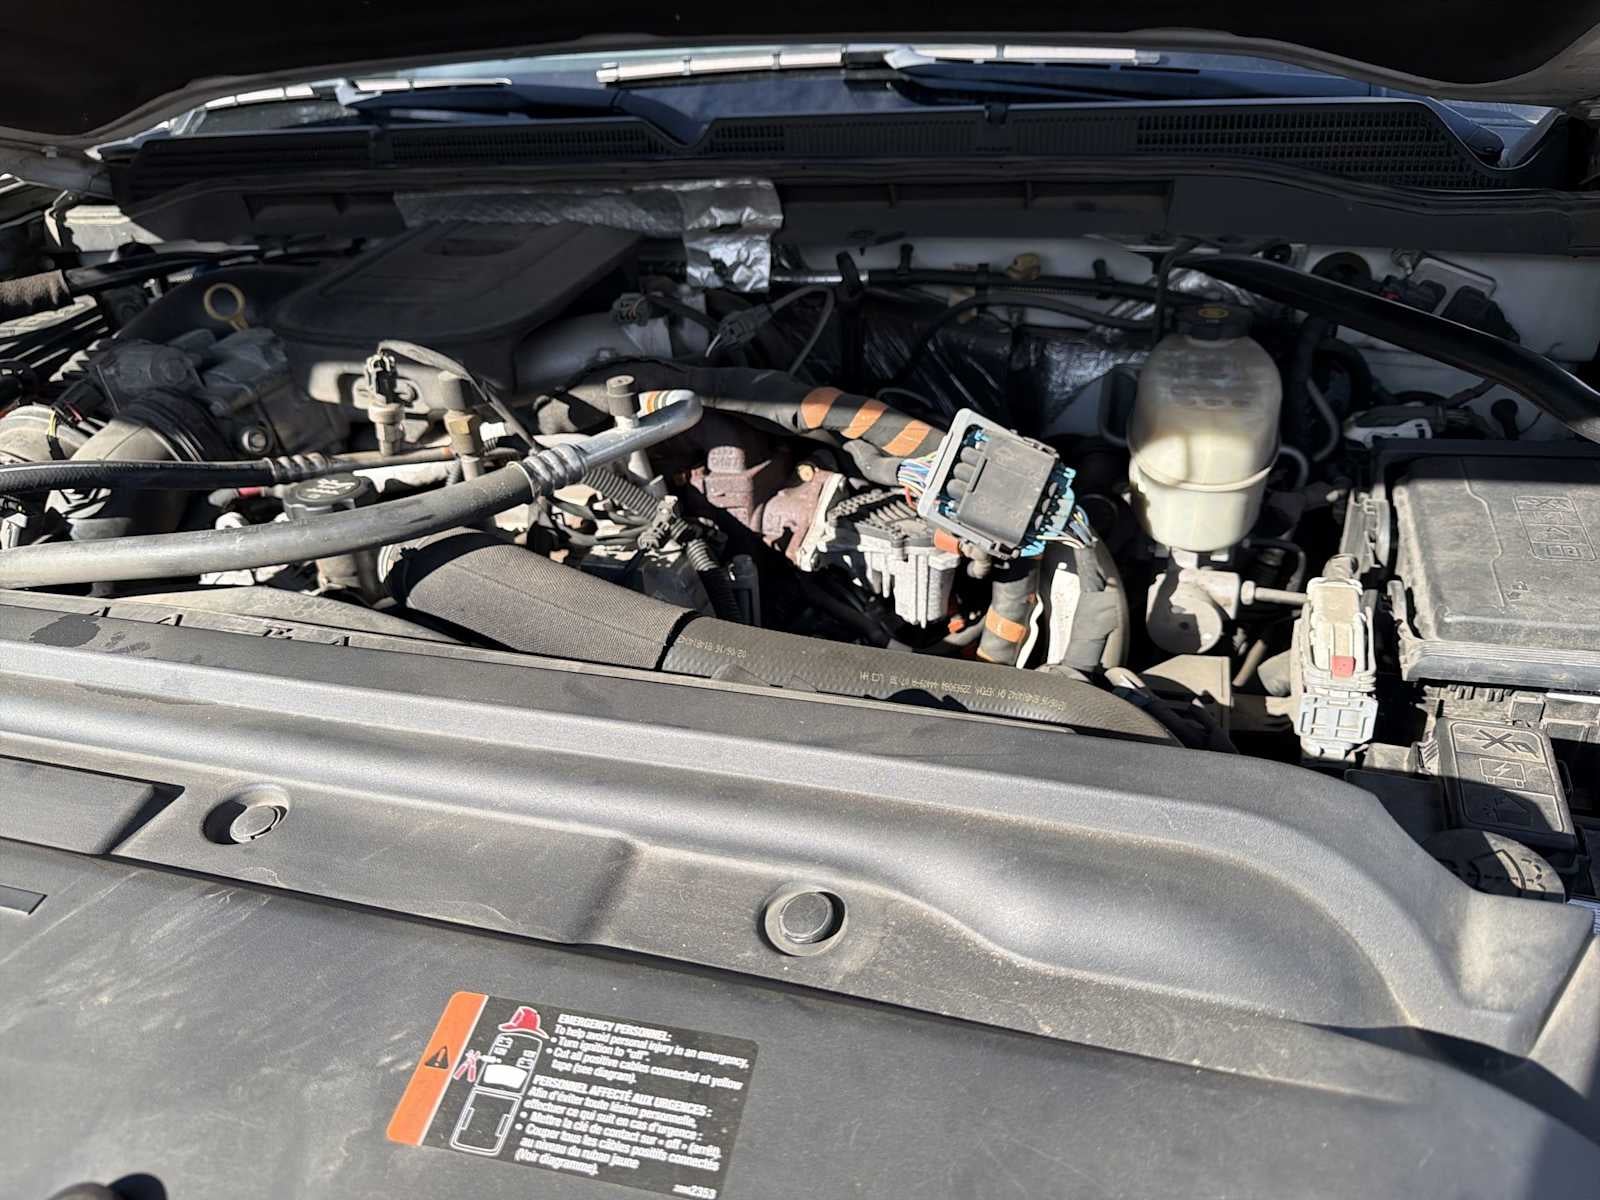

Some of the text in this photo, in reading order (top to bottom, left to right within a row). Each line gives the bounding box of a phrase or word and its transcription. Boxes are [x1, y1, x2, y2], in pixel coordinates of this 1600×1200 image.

[555, 1024, 566, 1034] To
[566, 1027, 585, 1039] help
[585, 1032, 610, 1043] avoid
[609, 1035, 648, 1049] personal
[648, 1040, 674, 1055] injury
[674, 1045, 684, 1055] in
[684, 1048, 697, 1057] an
[558, 1036, 579, 1048] Turn
[579, 1040, 613, 1055] ignition
[613, 1046, 625, 1057] to
[553, 1047, 570, 1059] Cut
[570, 1051, 583, 1060] all
[582, 1054, 619, 1067] positive
[619, 1060, 650, 1073] cables
[699, 1074, 711, 1084] at
[710, 1077, 743, 1090] yellow
[528, 1086, 548, 1098] Afin
[631, 1093, 654, 1106] AUX
[562, 1118, 573, 1129] la
[589, 1123, 603, 1135] de
[566, 1107, 579, 1117] ce
[579, 1110, 597, 1120] qui
[597, 1113, 616, 1124] suit
[616, 1117, 629, 1127] en
[629, 1119, 648, 1131] cas
